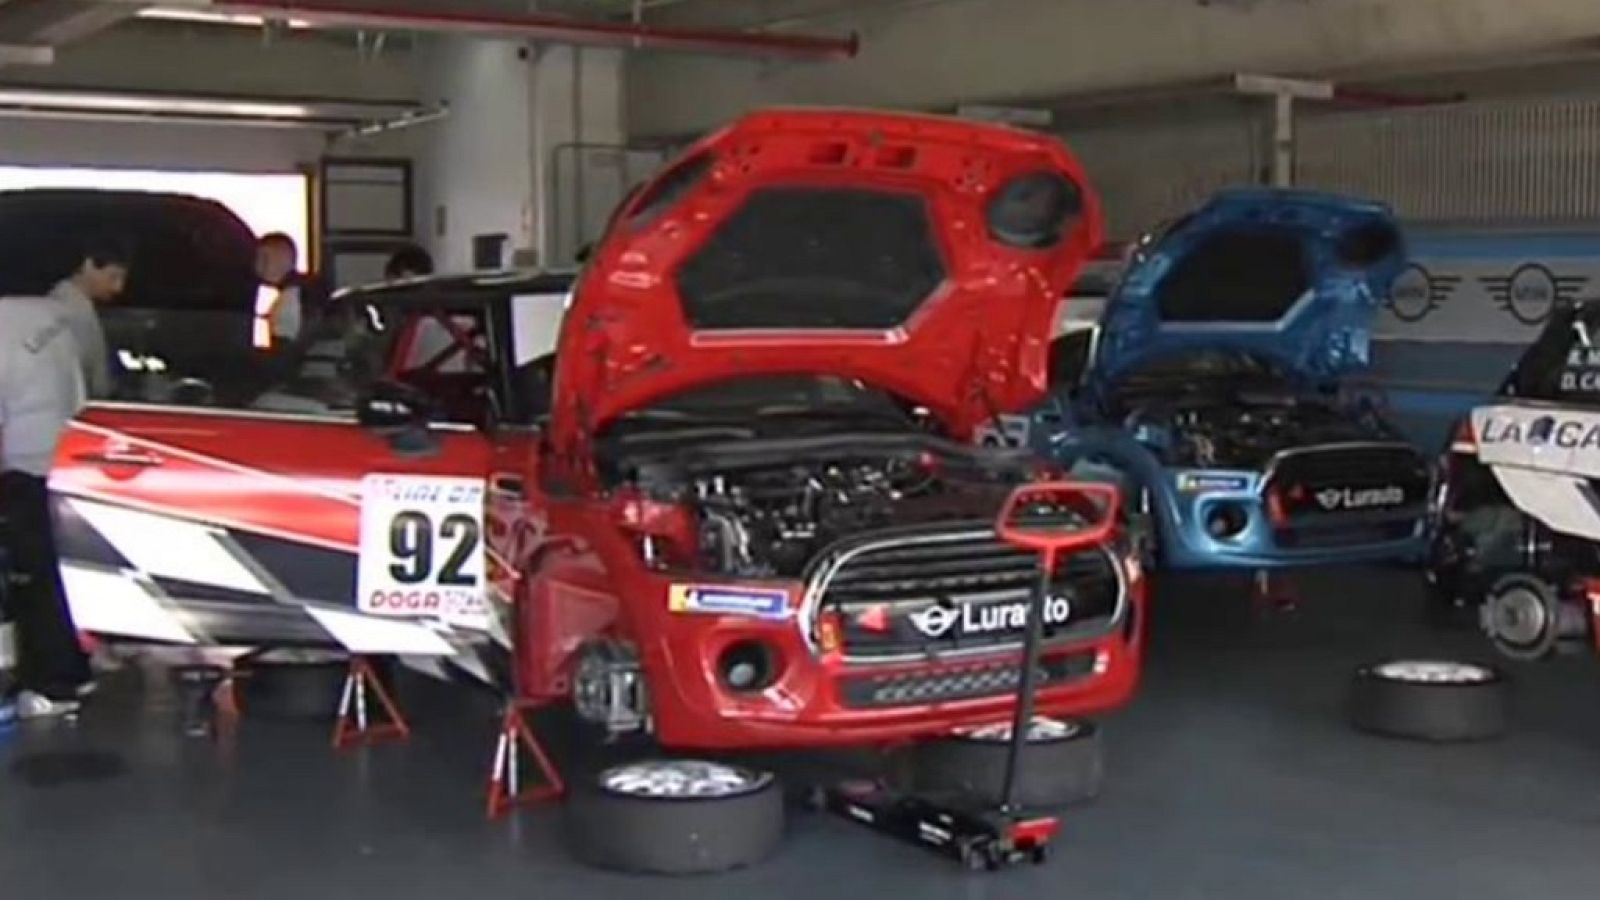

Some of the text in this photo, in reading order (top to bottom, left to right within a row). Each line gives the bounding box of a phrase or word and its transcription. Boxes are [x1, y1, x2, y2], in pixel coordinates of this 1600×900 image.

[388, 509, 479, 586] 92
[369, 590, 440, 609] DOGA
[963, 595, 1069, 632] Lurato
